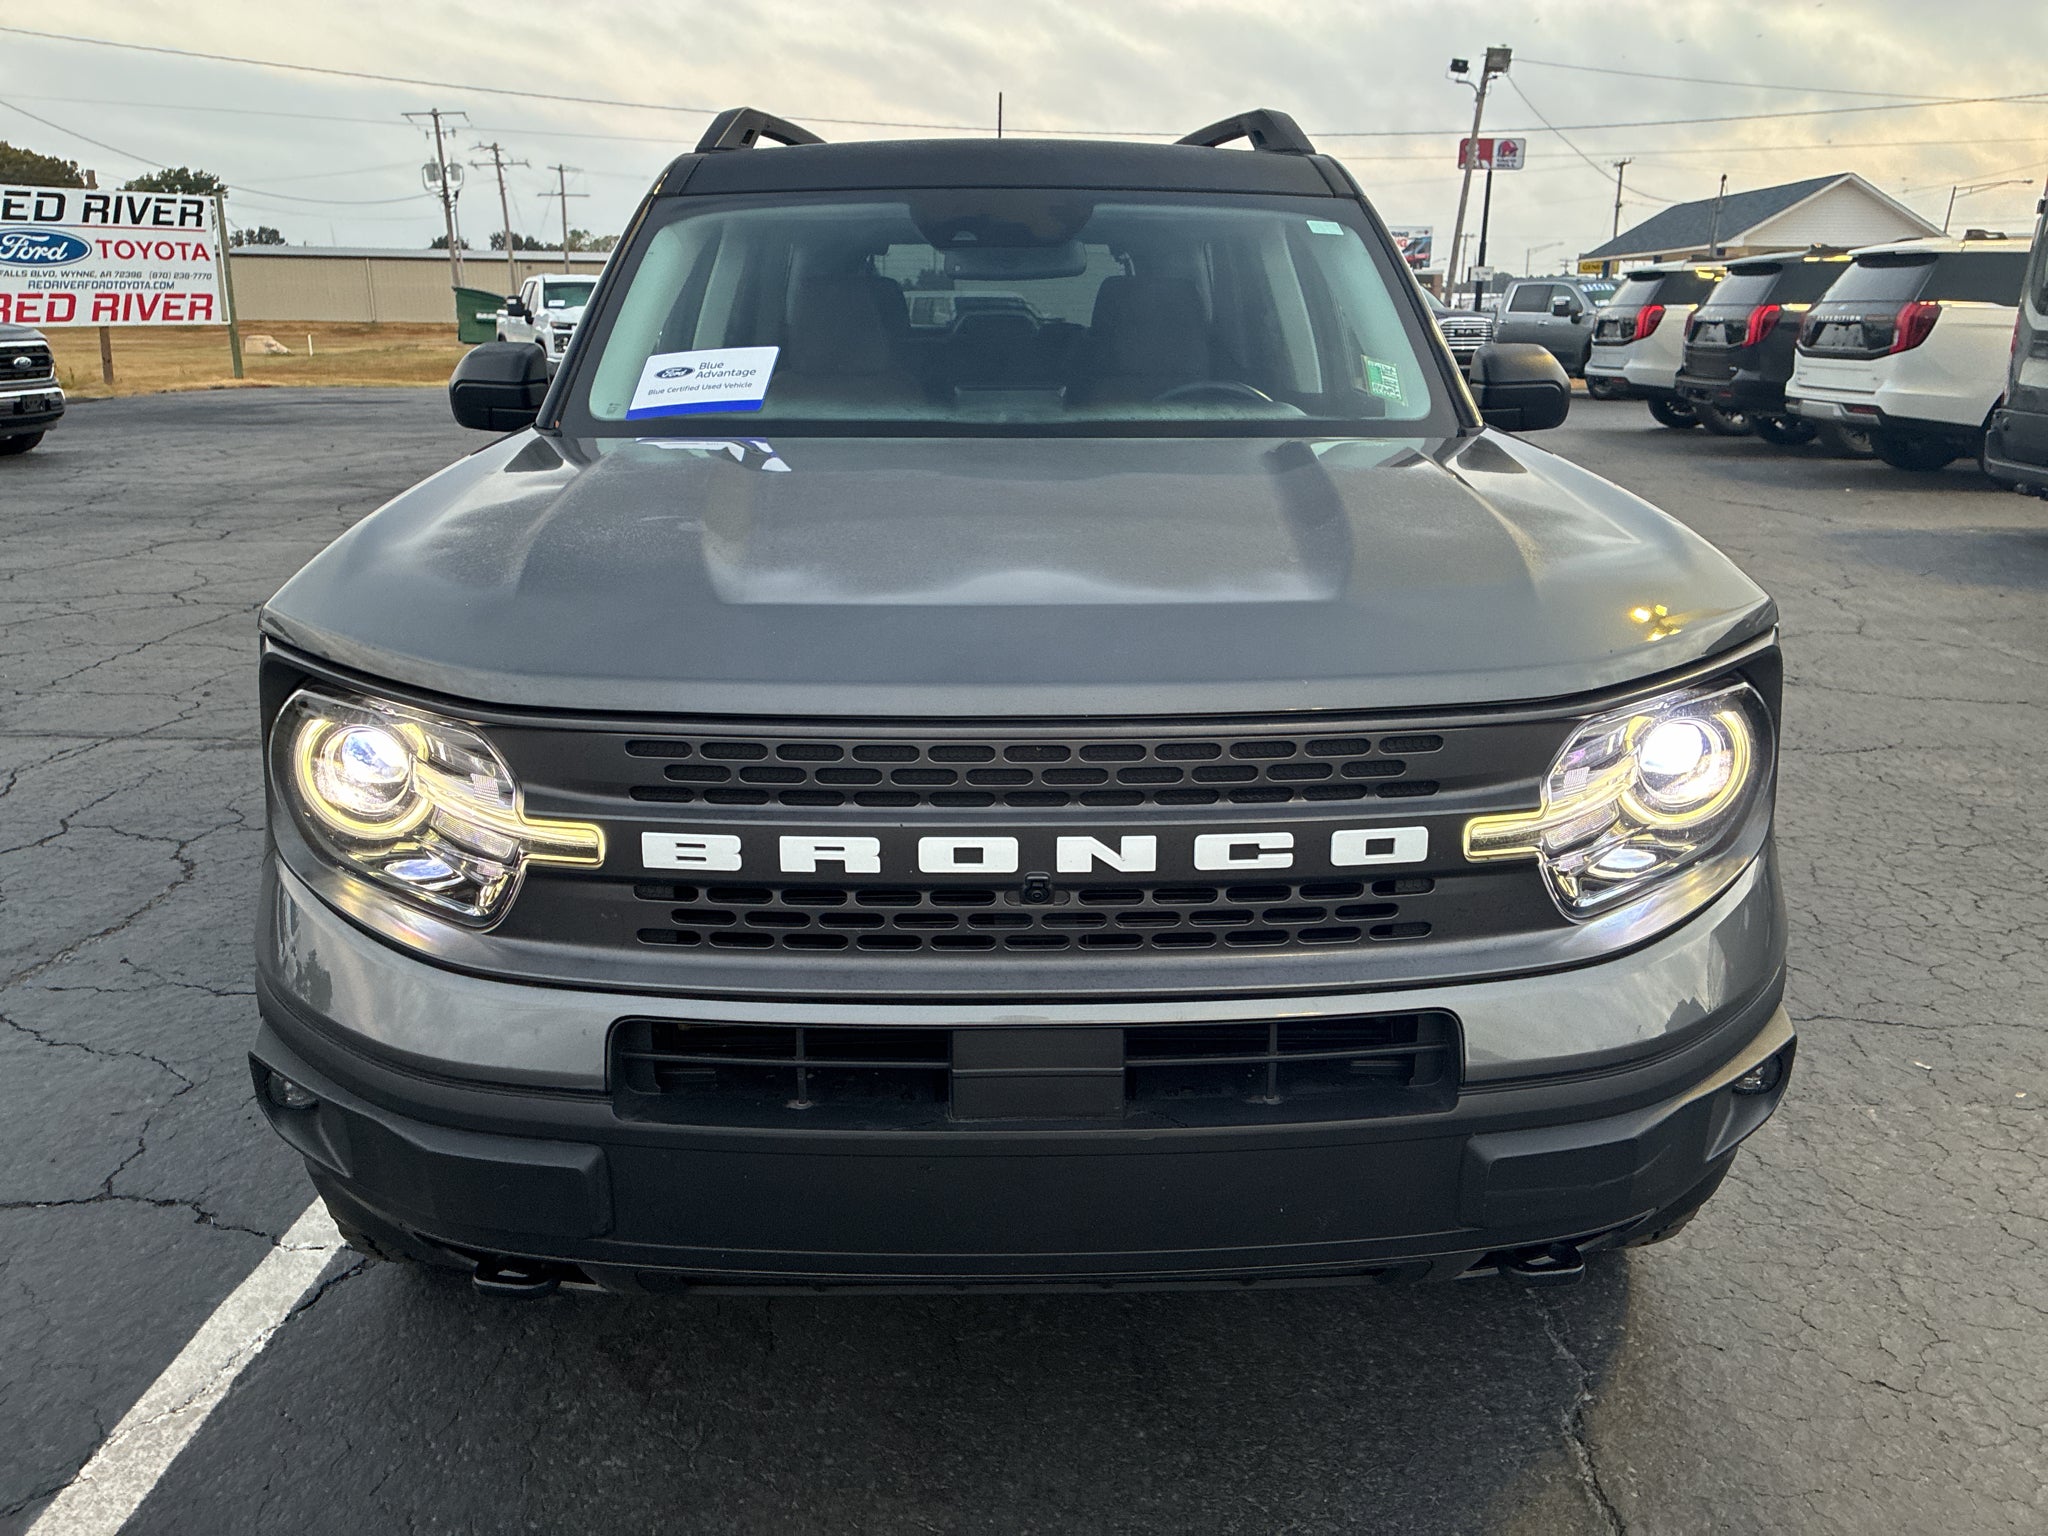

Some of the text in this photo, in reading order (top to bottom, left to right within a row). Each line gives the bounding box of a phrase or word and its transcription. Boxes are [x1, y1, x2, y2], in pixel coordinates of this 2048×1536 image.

[82, 194, 204, 227] RIVER
[0, 233, 69, 261] Ford
[95, 239, 211, 261] TOYOTA
[28, 281, 175, 290] REDRIVERFORDTOYOTA.COM
[92, 293, 214, 322] RIVER
[696, 368, 757, 379] Advantage
[699, 361, 724, 370] Blue
[648, 381, 753, 396] Blue Certified Used Vehicle
[641, 825, 1430, 873] BRONCO
